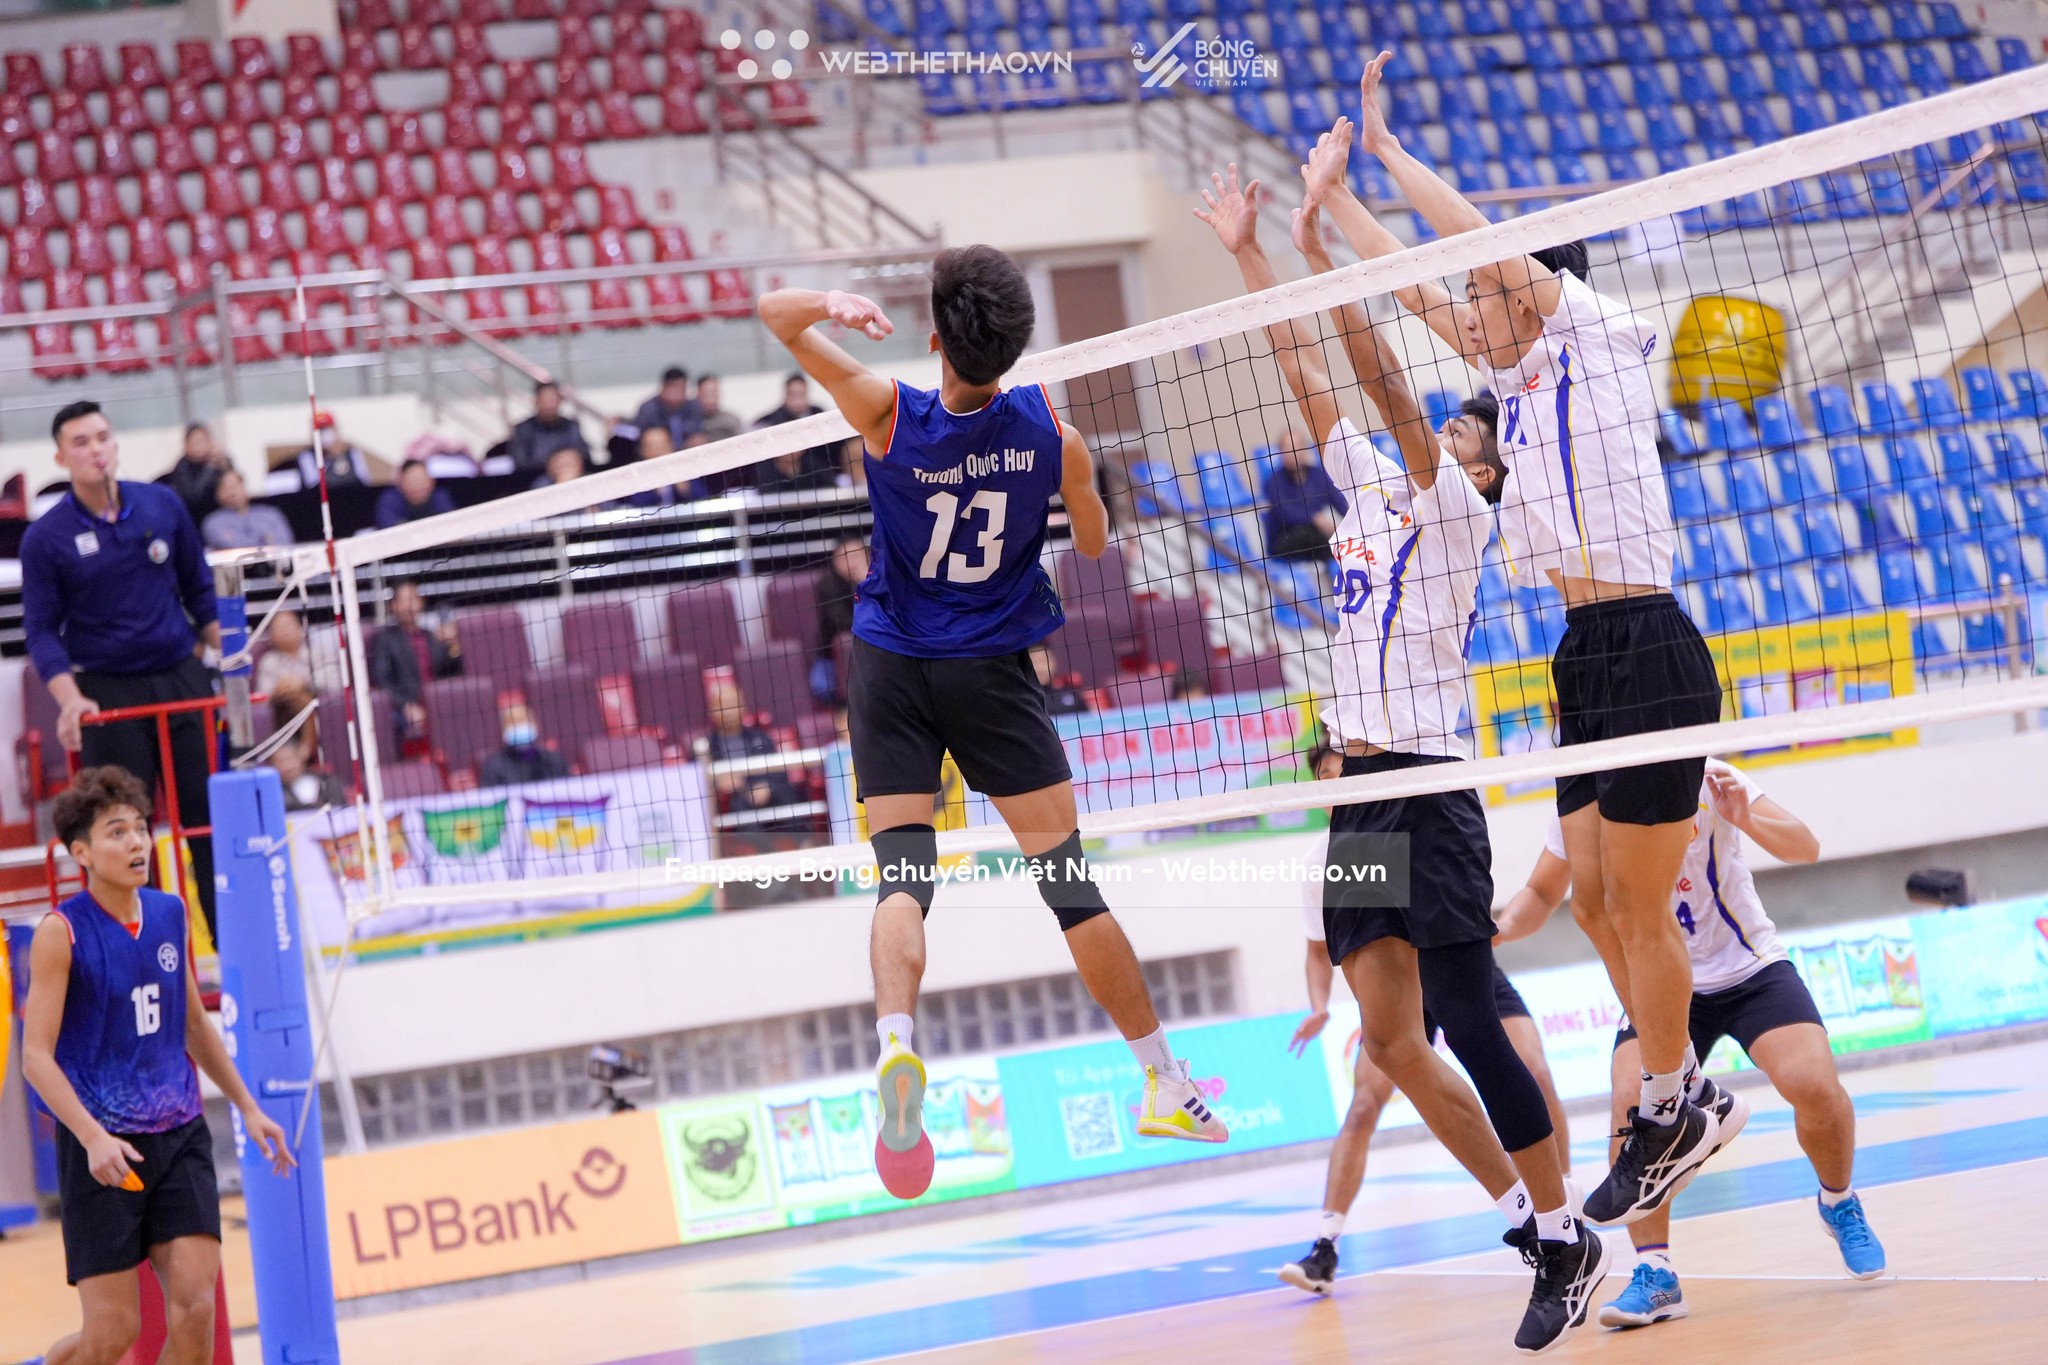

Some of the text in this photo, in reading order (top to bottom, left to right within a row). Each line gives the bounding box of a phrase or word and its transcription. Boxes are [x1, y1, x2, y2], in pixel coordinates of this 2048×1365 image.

[1004, 448, 1035, 472] Huy
[919, 490, 1008, 583] 13
[130, 983, 161, 1037] 16
[347, 1180, 577, 1264] LPBank
